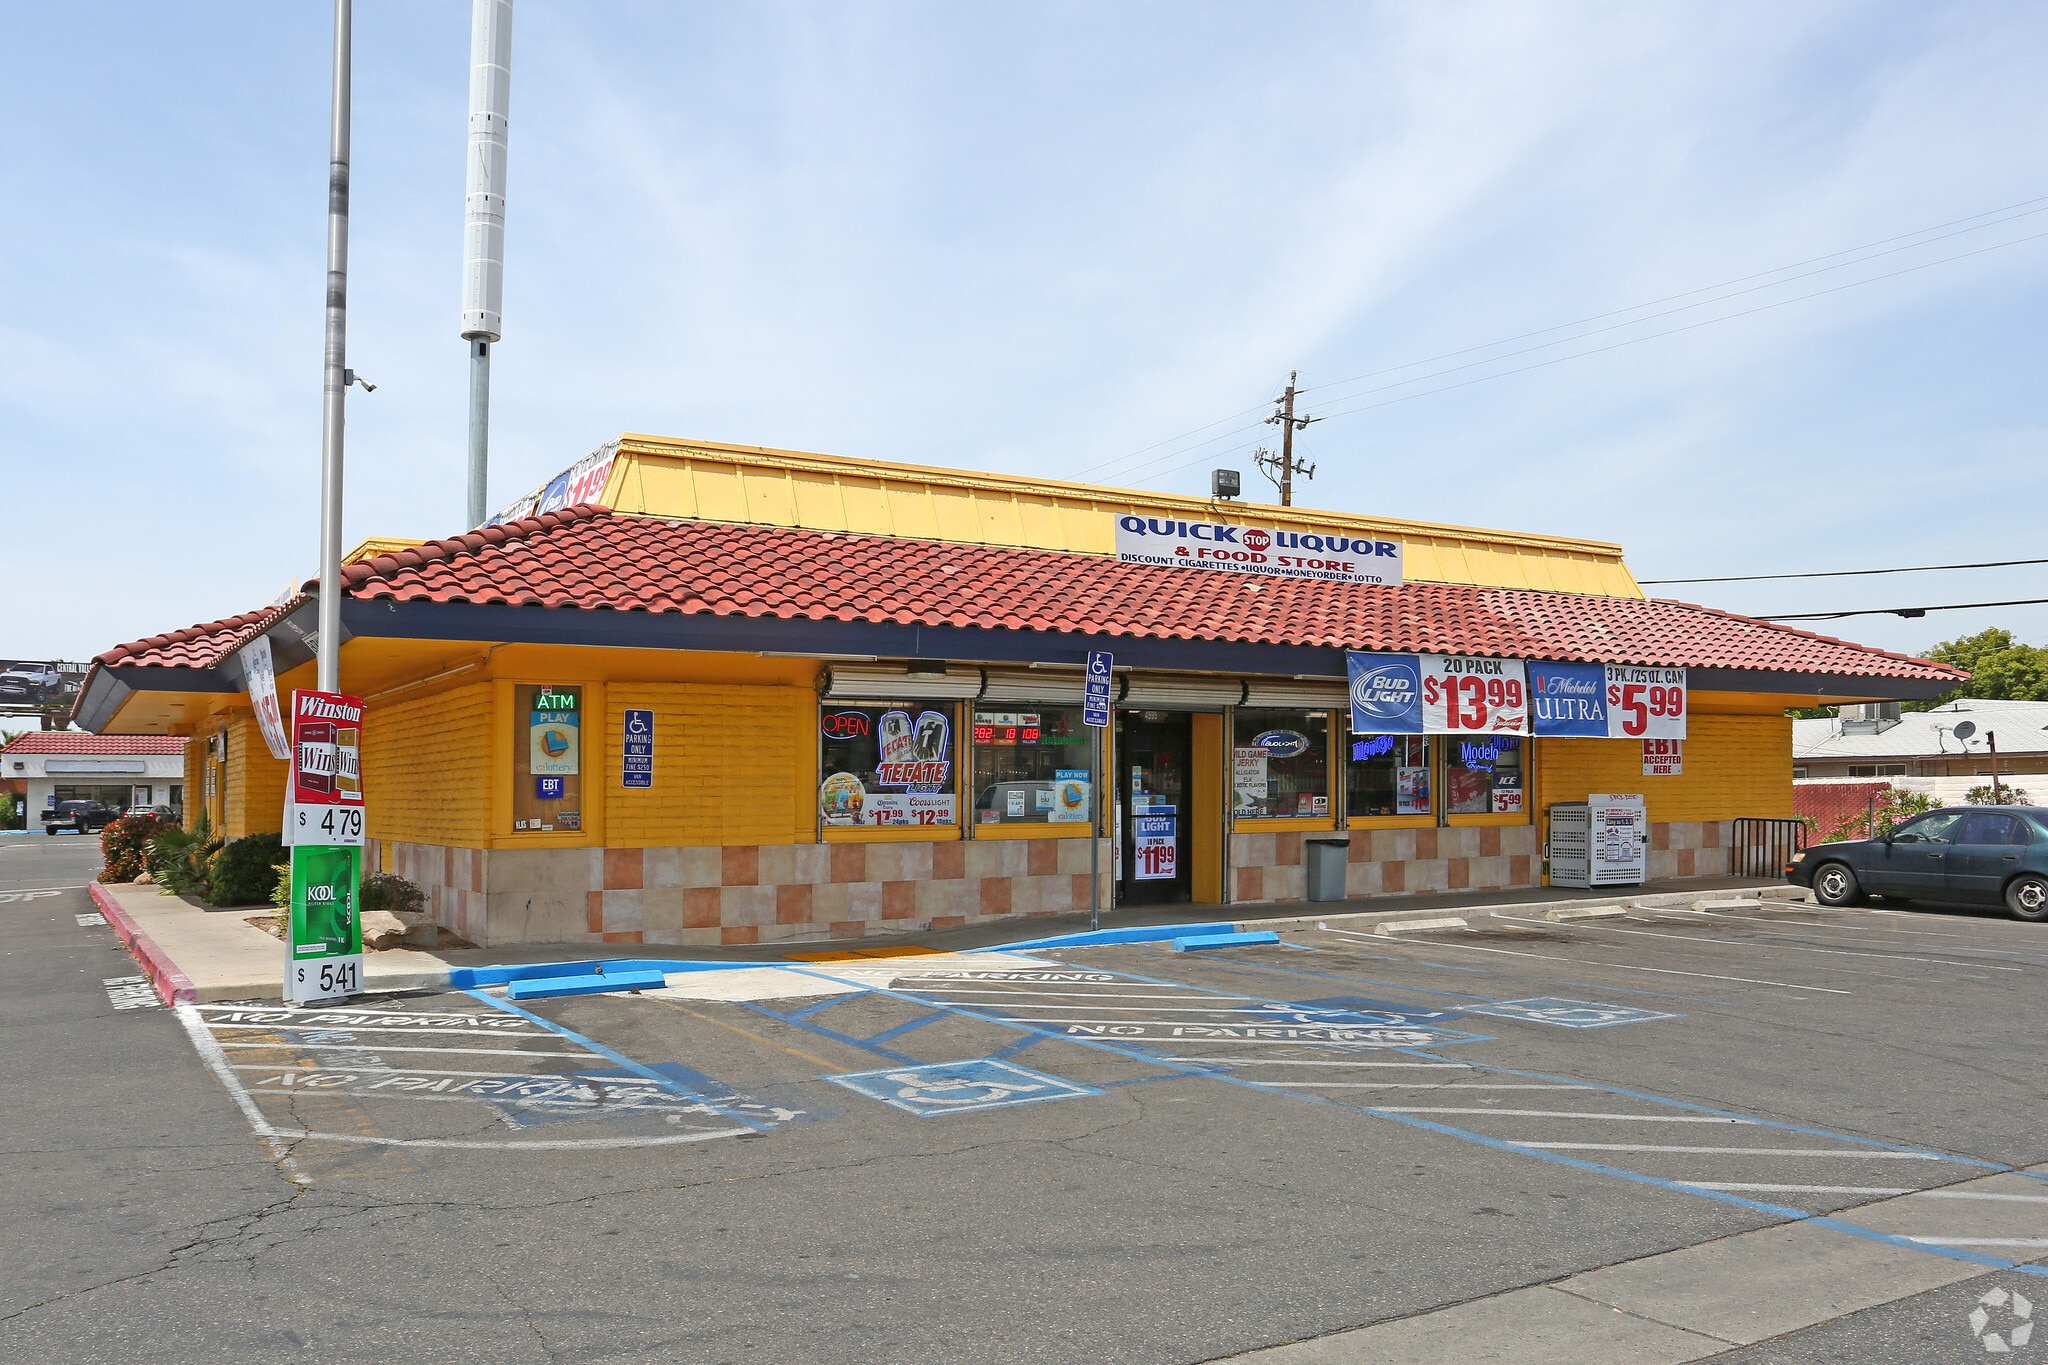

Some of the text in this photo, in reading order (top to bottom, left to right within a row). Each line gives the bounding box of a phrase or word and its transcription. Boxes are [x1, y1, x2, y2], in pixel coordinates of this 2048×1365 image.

[1120, 516, 1397, 559] QUICK STOP LIQUOR
[1174, 545, 1355, 573] & FOOD STORE
[1121, 553, 1175, 566] DISCOUNT
[1178, 559, 1240, 572] CIGARETTES
[1354, 574, 1383, 584] LOTTO
[57, 663, 77, 673] CENTRAL
[1443, 658, 1503, 675] 20 PACK
[1088, 674, 1109, 685] PARKING
[1372, 676, 1410, 690] BUD
[1607, 668, 1613, 681] 3
[1665, 671, 1685, 685] CAN
[1091, 684, 1105, 694] ONLY
[1547, 676, 1598, 695] Michelob
[537, 694, 574, 709] ATM
[1362, 689, 1415, 703] LIGHT
[299, 695, 361, 723] Winston
[1535, 698, 1604, 720] ULTRA
[540, 713, 570, 723] PLAY
[822, 714, 871, 737] OPEN
[625, 734, 652, 744] PARKING
[1006, 728, 1016, 739] 18
[1021, 728, 1039, 739] 108
[630, 745, 646, 755] ONLY
[883, 734, 912, 758] TECATE
[1461, 741, 1499, 761] Modelo
[1248, 750, 1267, 758] GAME
[1644, 755, 1682, 764] ACCEPTED
[1237, 759, 1259, 767] JERKY
[1653, 765, 1672, 774] HERE
[879, 762, 947, 784] TECATE
[542, 779, 559, 790] EBT
[1498, 776, 1518, 785] ICE
[909, 796, 931, 808] Coors
[299, 811, 307, 827] $
[1141, 822, 1170, 832] LIGHT
[308, 885, 336, 901] KOOL
[298, 962, 356, 993] $ 5.41
[919, 969, 1114, 983] PARKING
[209, 1011, 530, 1028] NO PARKING
[1066, 1024, 1146, 1036] NO
[256, 1072, 358, 1088] NO
